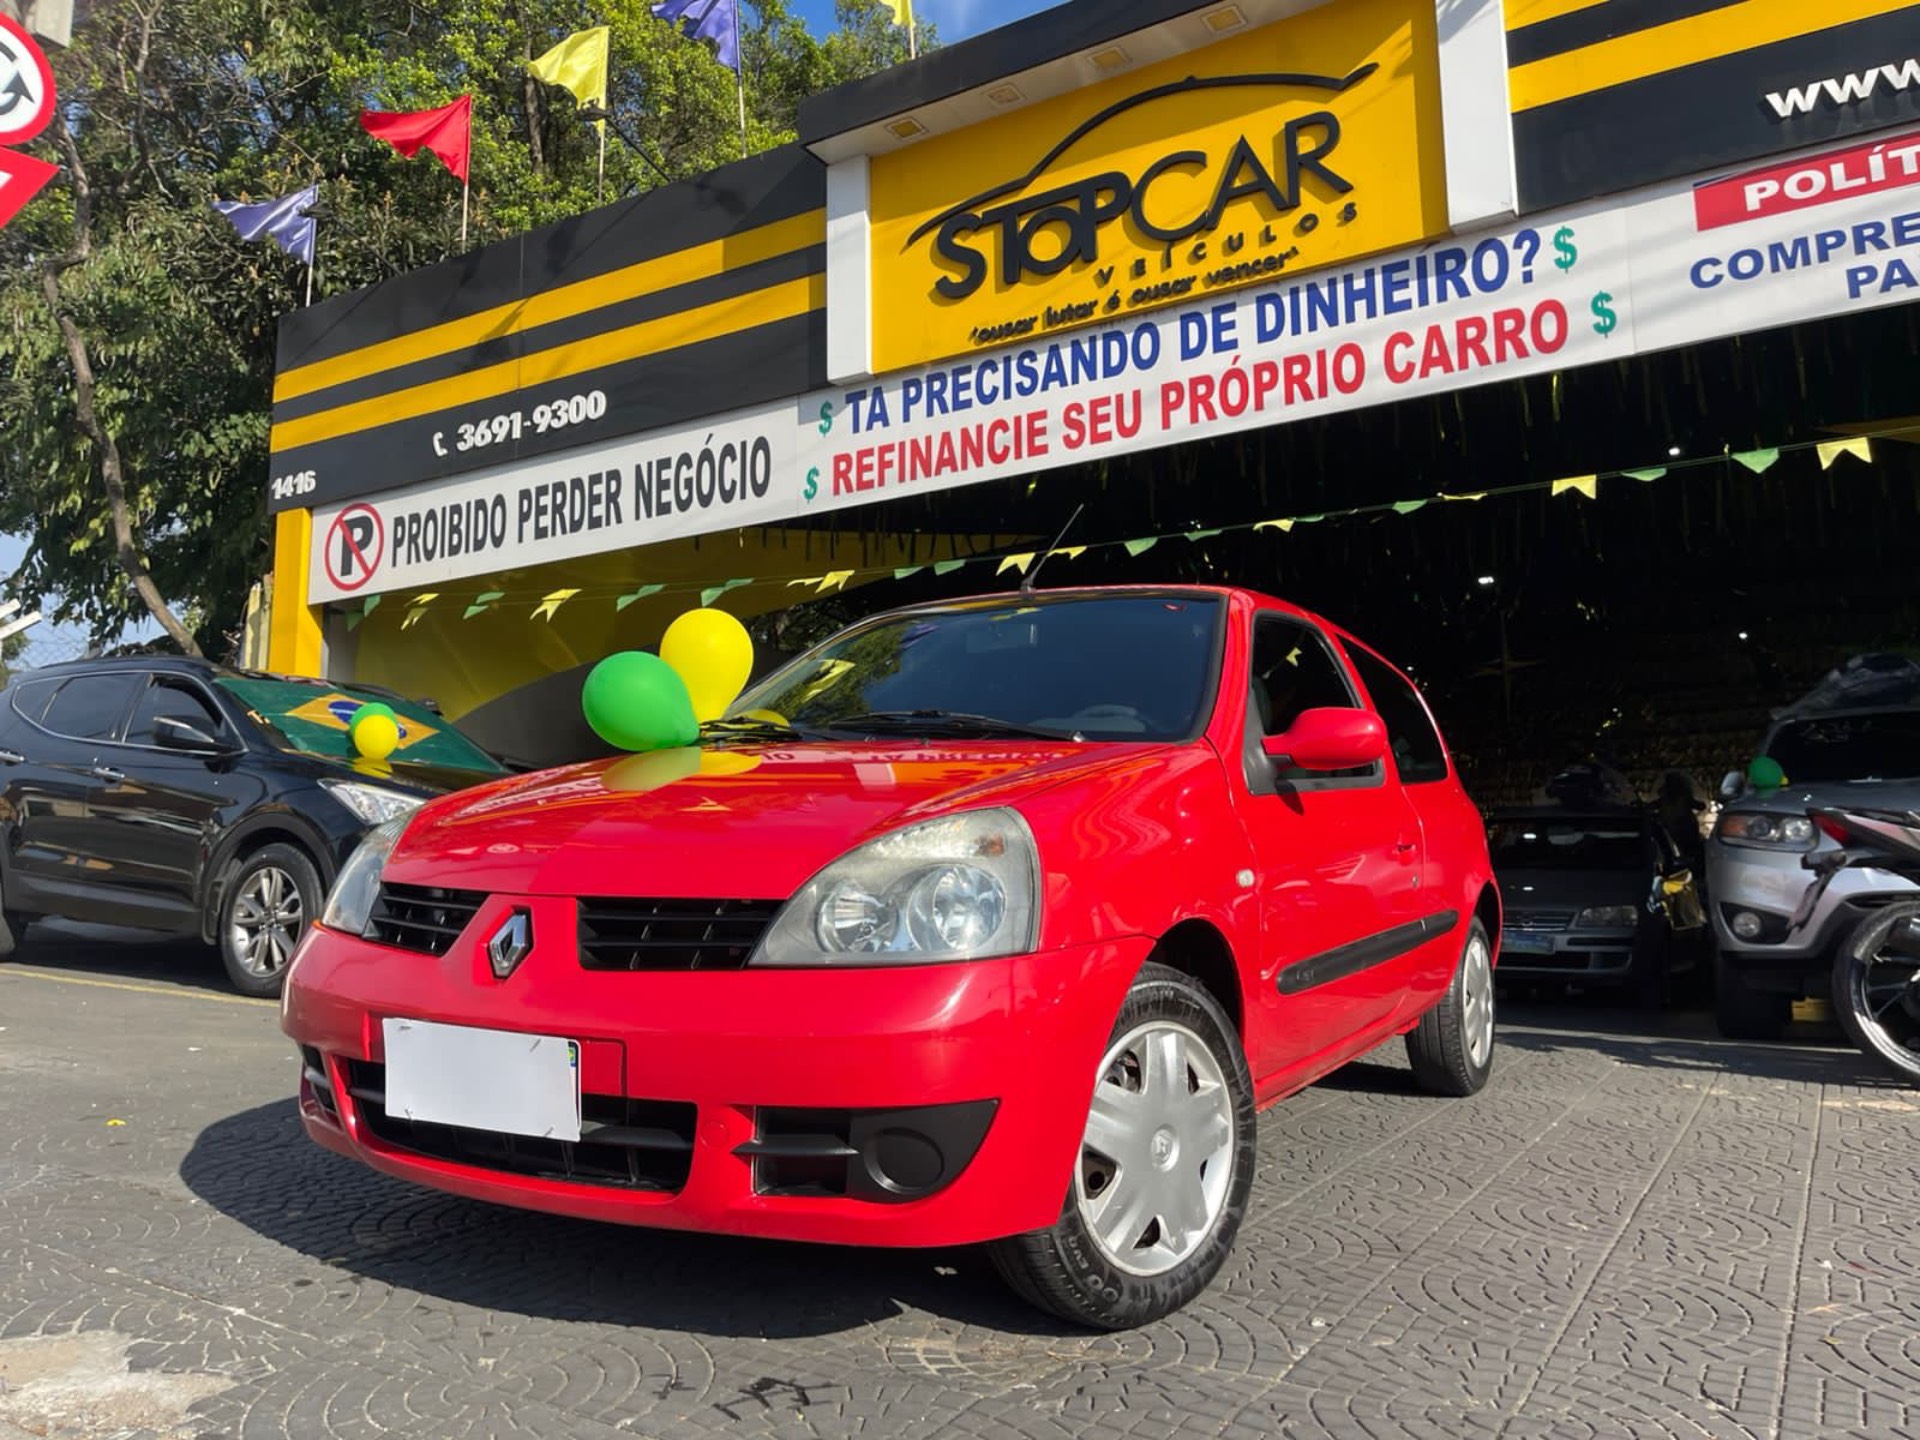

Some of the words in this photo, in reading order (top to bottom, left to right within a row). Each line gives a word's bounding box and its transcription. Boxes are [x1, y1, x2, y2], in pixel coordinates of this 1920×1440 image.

[1098, 201, 1358, 288] VEÍCULOS
[1690, 211, 1920, 289] COMPRE
[1131, 274, 1198, 302] ousar
[845, 385, 890, 435] TA
[902, 320, 1162, 424] PRECISANDO
[1179, 301, 1239, 362] DE
[1255, 228, 1542, 345] DINHEIRO?
[456, 389, 608, 452] 3691-9300
[832, 410, 1050, 497] REFINANCIE
[1062, 388, 1143, 450] SEU
[1160, 341, 1367, 431] PRÓPRIO
[1382, 298, 1570, 385] CARRO
[270, 469, 317, 500] 1416
[391, 494, 507, 568] PROIBIDO
[517, 468, 623, 544] PERDER
[633, 432, 772, 521] NEGÓCIO
